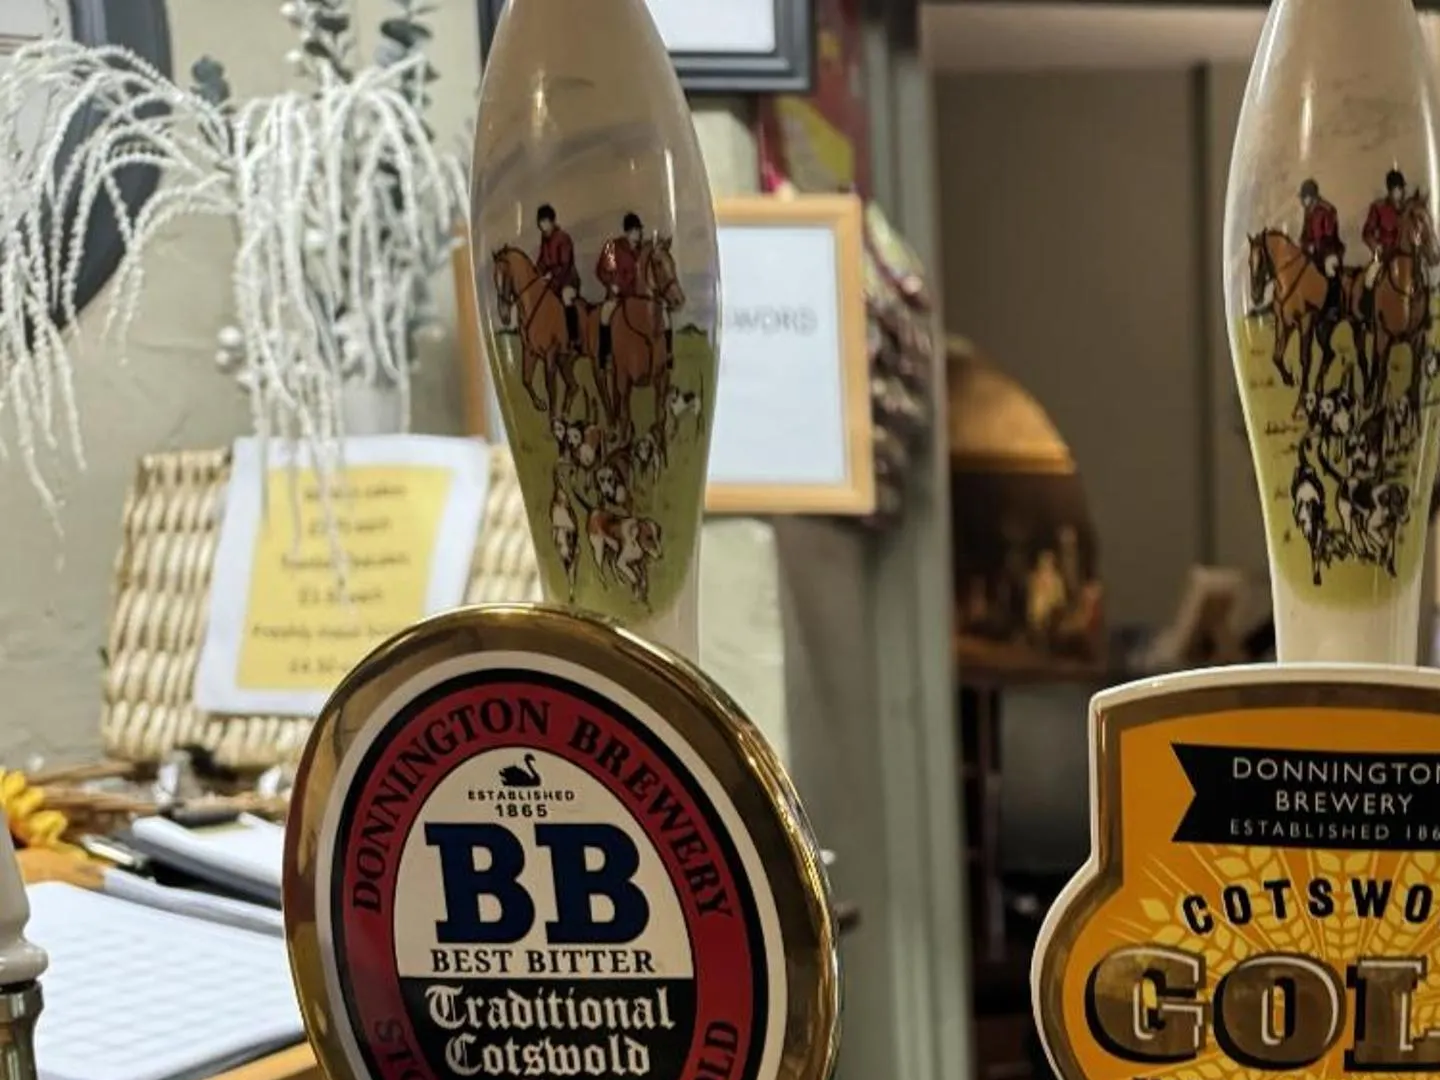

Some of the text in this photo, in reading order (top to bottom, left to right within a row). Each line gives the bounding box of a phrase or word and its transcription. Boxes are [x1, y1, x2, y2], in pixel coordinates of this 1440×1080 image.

[353, 698, 733, 918] DONNINGTON BREWERY
[468, 790, 575, 801] ESTABLISHED
[1275, 789, 1413, 815] BREWERY
[495, 804, 548, 818] 1865
[1230, 818, 1390, 841] ESTABLISHED
[424, 822, 650, 945] BB
[430, 948, 656, 973] BEST BITTER
[425, 983, 675, 1030] Traditional
[445, 1031, 650, 1076] Cotswold
